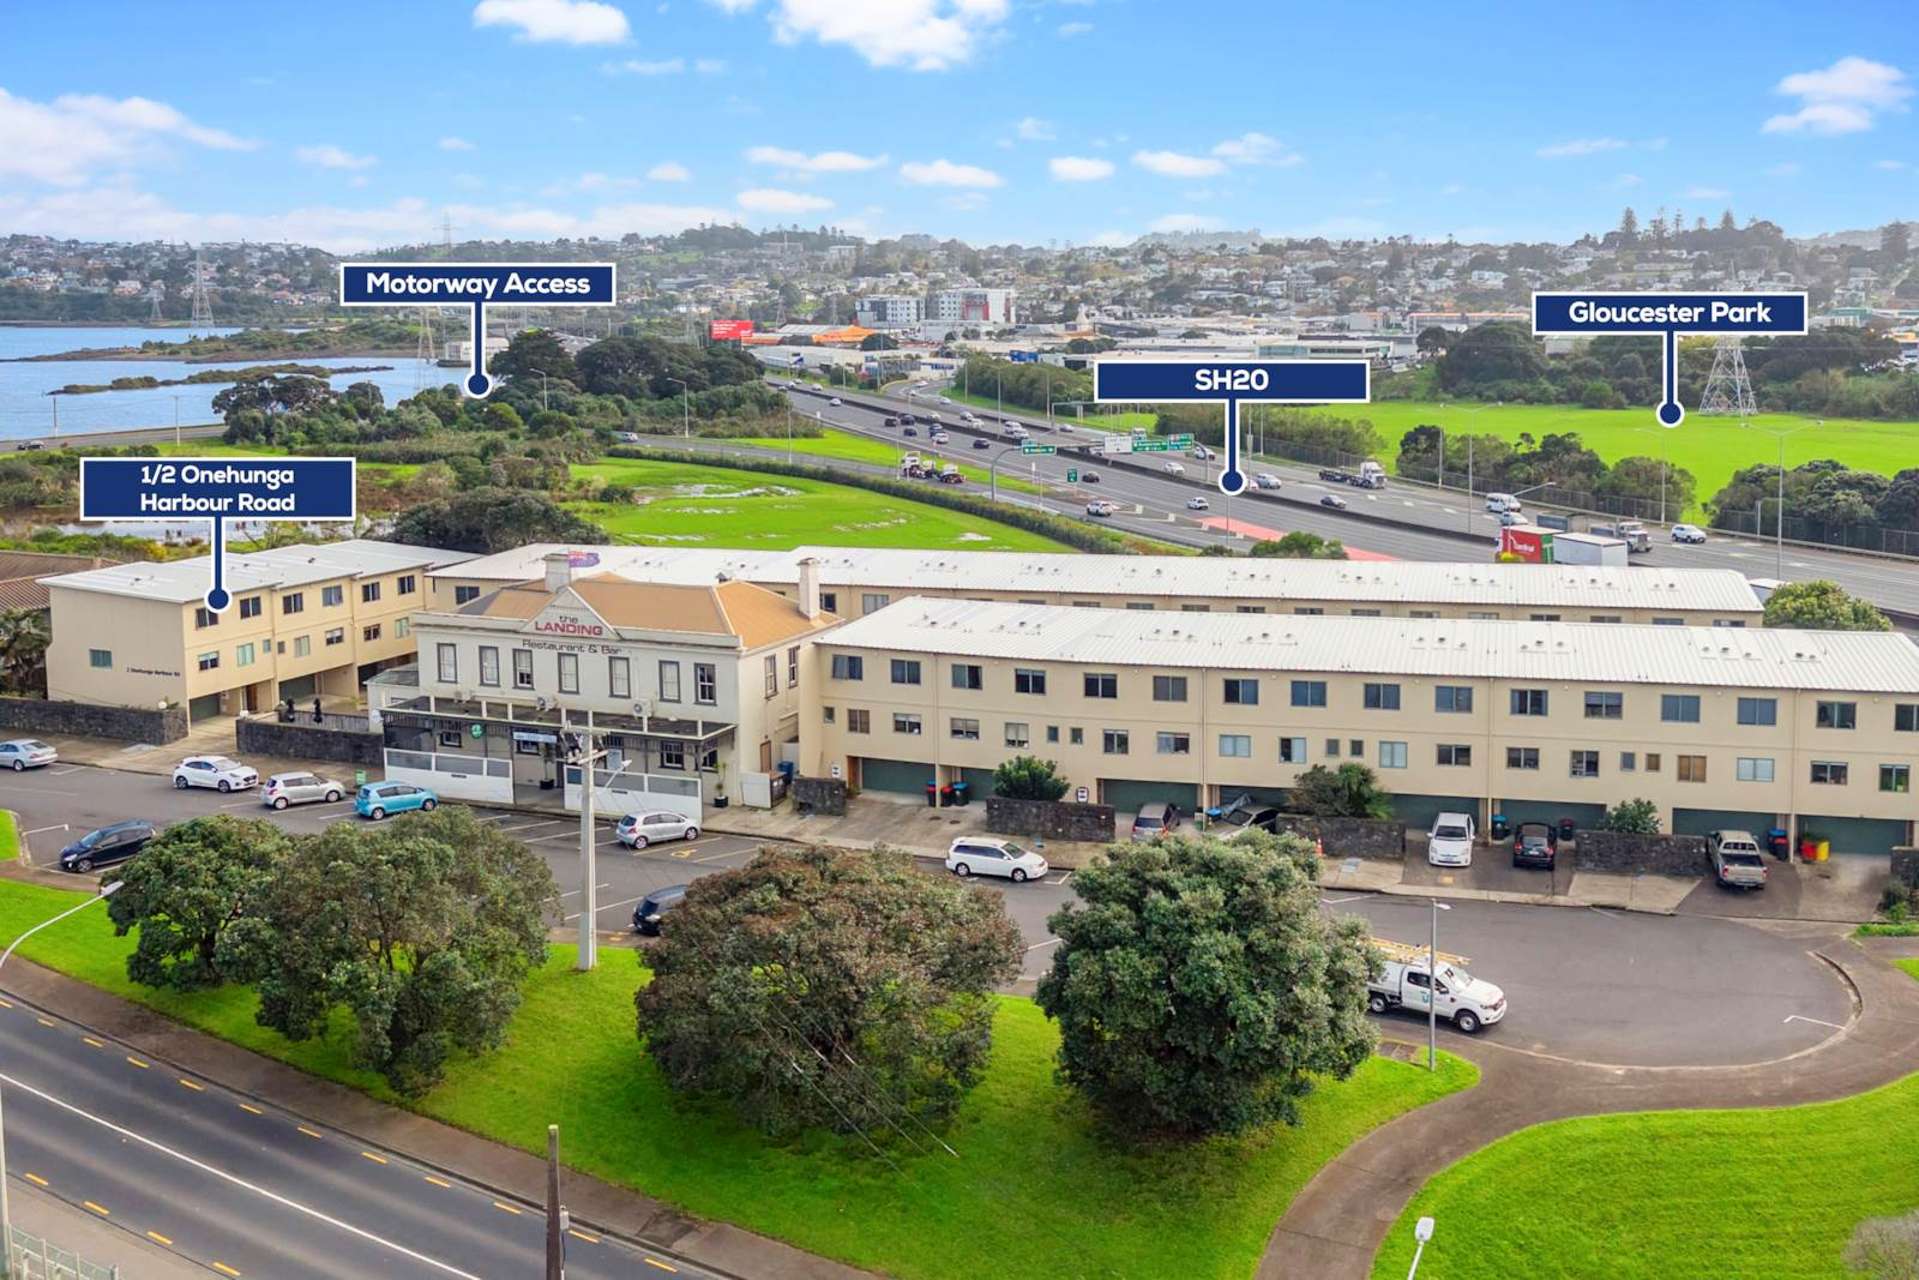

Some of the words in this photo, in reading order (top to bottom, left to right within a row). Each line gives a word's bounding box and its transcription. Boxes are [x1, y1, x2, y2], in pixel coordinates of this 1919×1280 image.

[559, 615, 578, 624] the
[534, 621, 603, 636] LANDING
[522, 639, 585, 653] Restaurant
[588, 643, 598, 653] &
[601, 644, 623, 655] Bar
